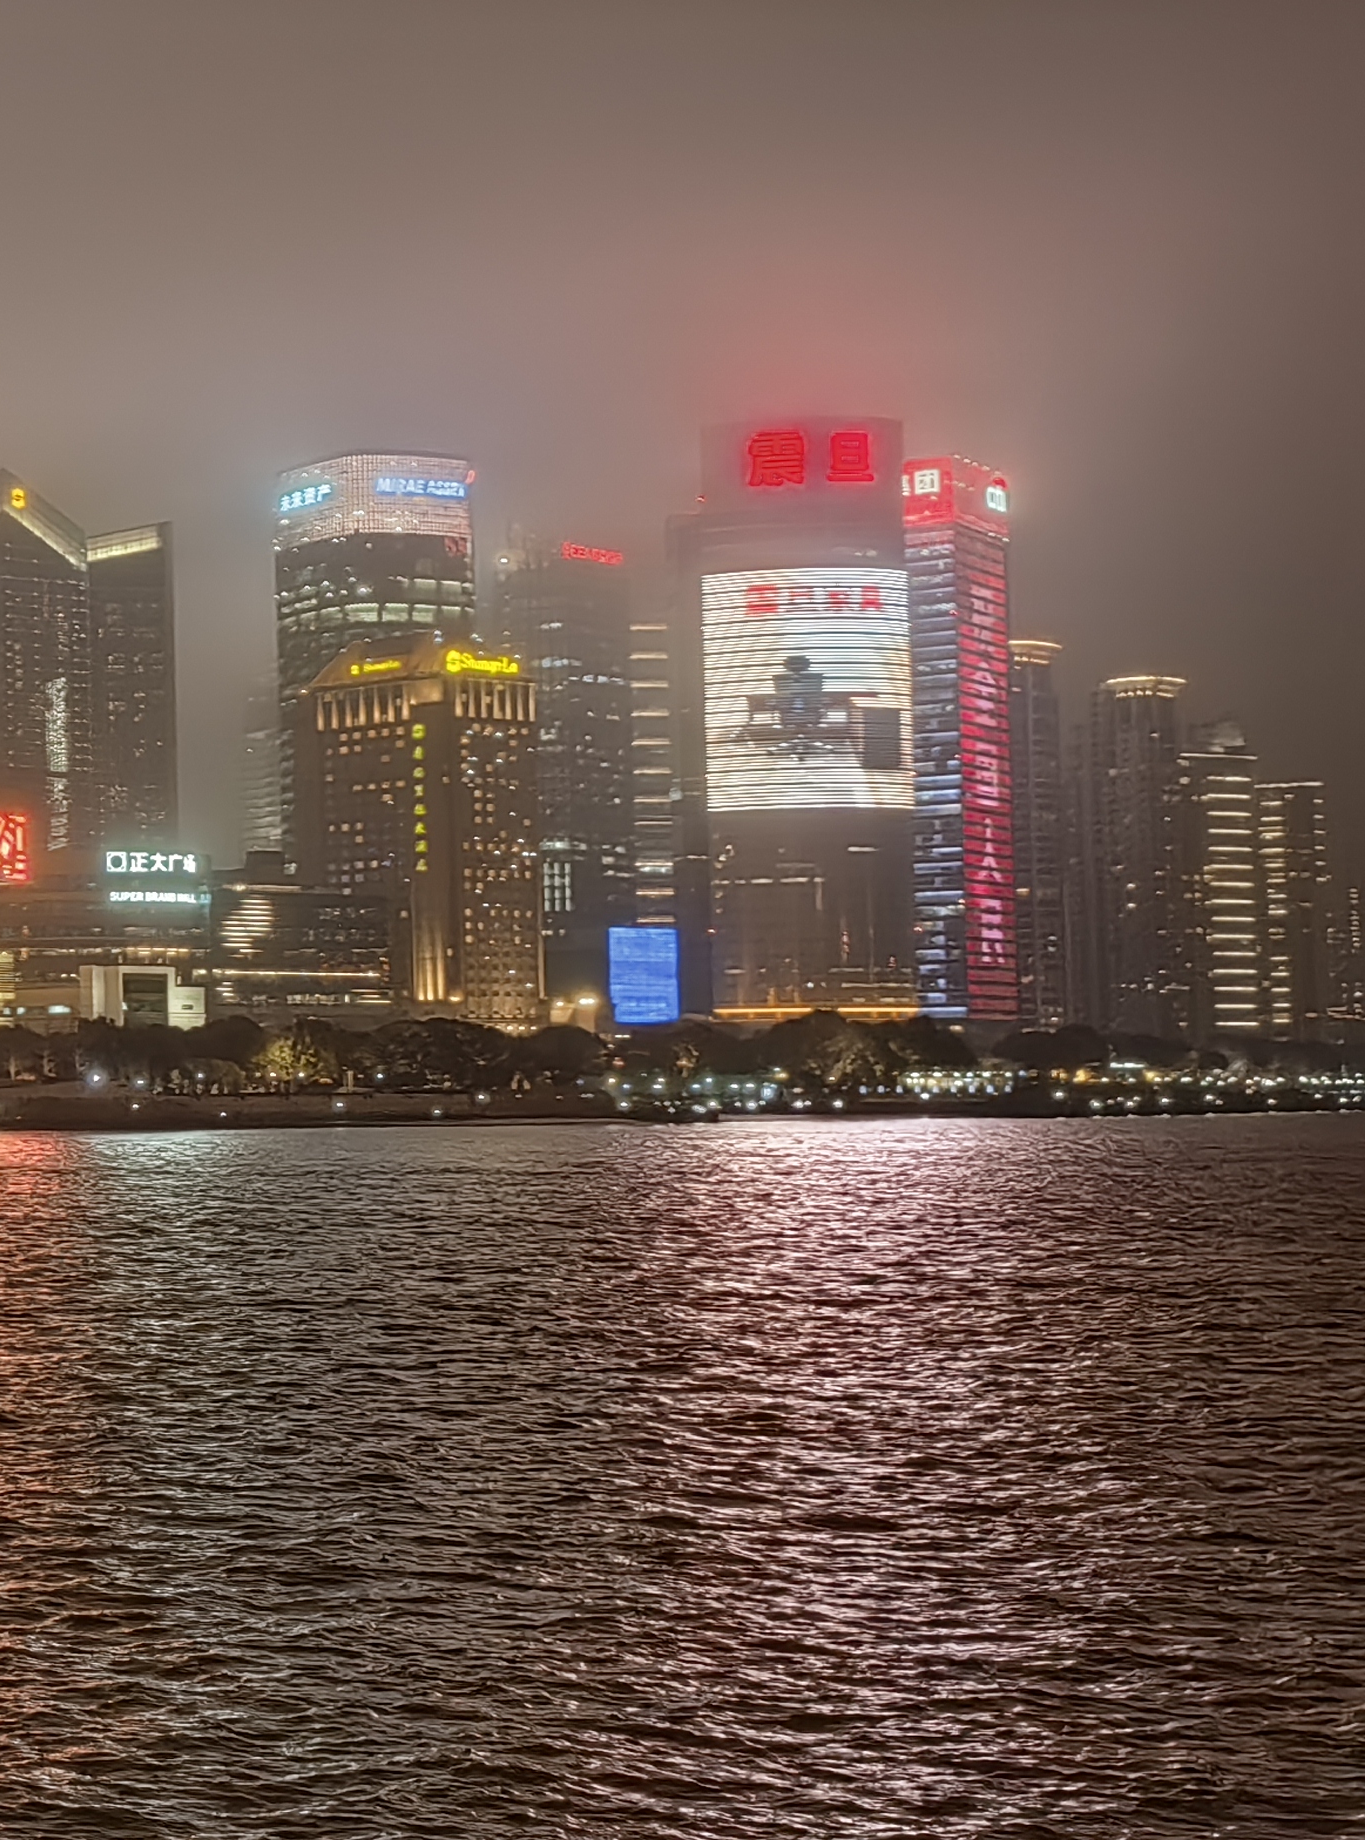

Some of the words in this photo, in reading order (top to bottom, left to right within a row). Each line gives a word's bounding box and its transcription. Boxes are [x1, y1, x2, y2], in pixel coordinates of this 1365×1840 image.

[747, 430, 875, 487] 震旦
[376, 478, 425, 493] MIRAE
[280, 484, 332, 511] 未来资产
[129, 852, 196, 872] 正大广场
[110, 892, 144, 901] SUPER
